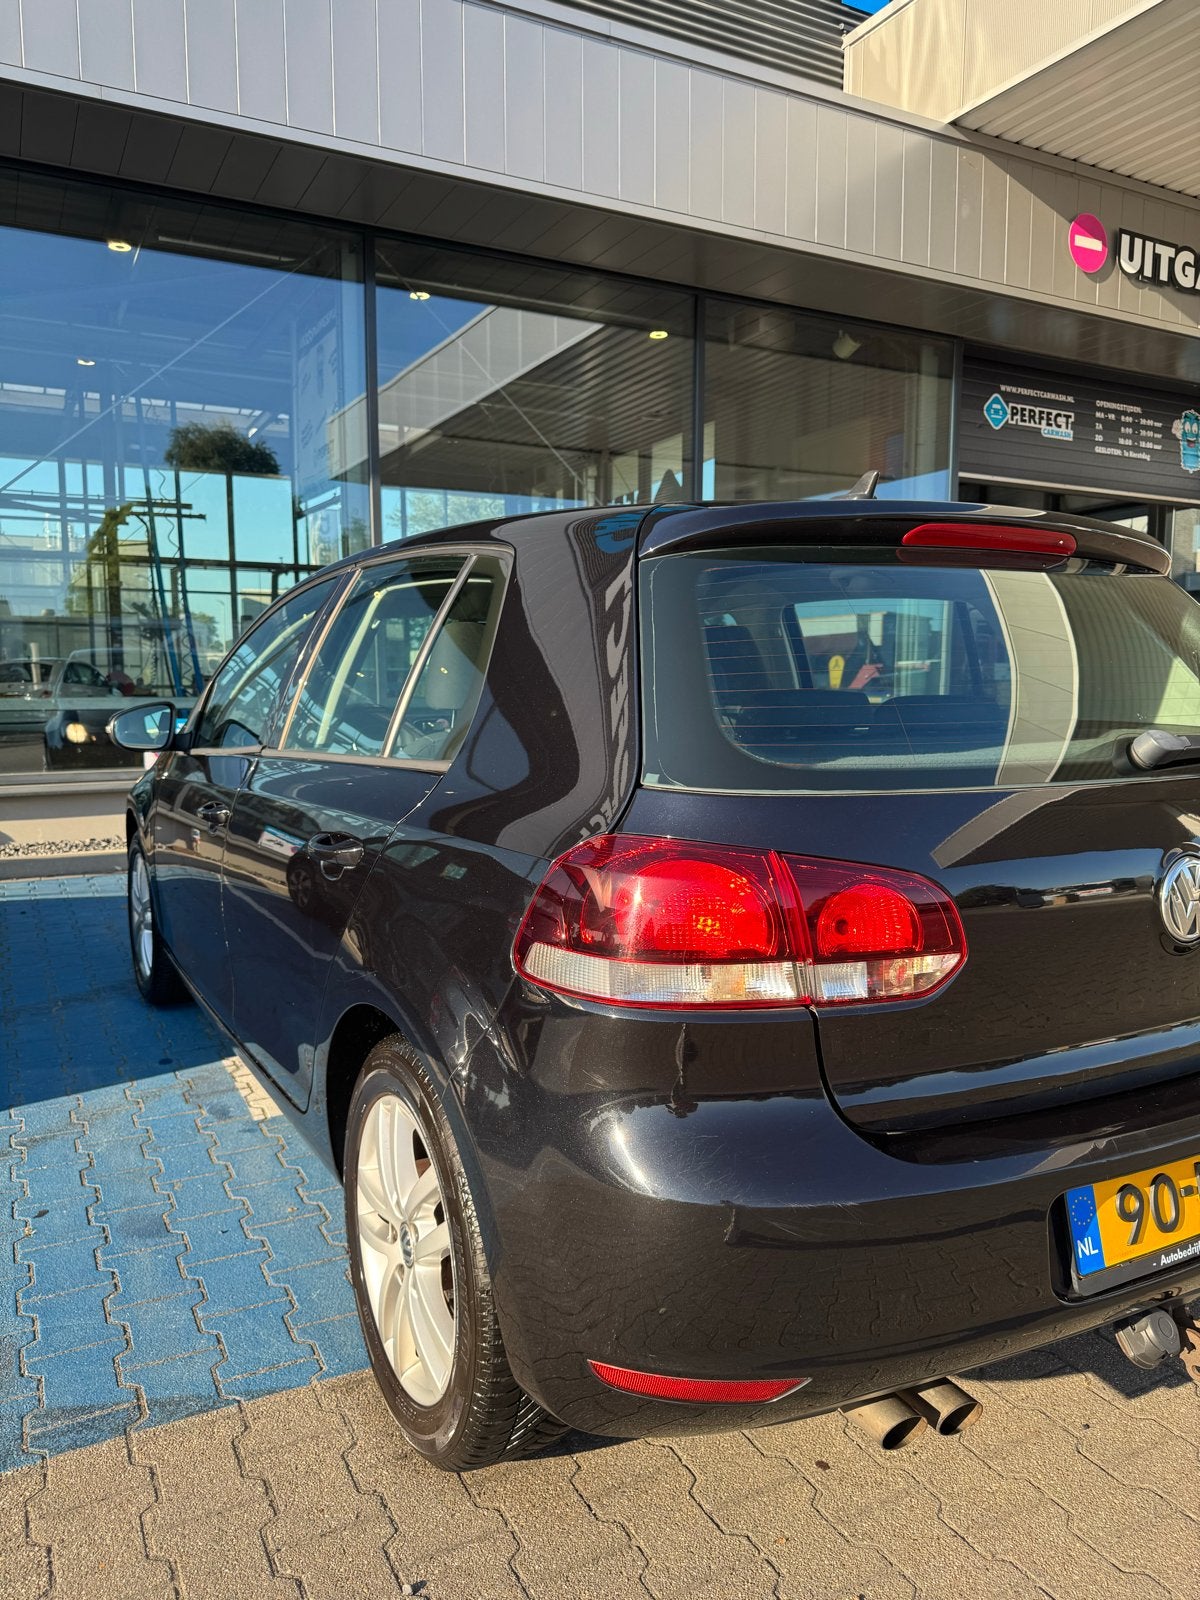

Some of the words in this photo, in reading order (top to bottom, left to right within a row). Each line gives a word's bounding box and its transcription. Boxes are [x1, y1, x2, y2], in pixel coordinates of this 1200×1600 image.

[1119, 232, 1200, 291] UITG
[999, 384, 1075, 403] WWW.PERFECTCARWASH.NL
[1010, 405, 1072, 430] PERFECT
[1095, 411, 1104, 419] MA
[1043, 428, 1073, 440] CARWASH
[1095, 422, 1103, 430] ZA
[1129, 450, 1151, 461] Kerstdag
[1115, 1161, 1200, 1246] 90-
[1077, 1236, 1099, 1258] NL
